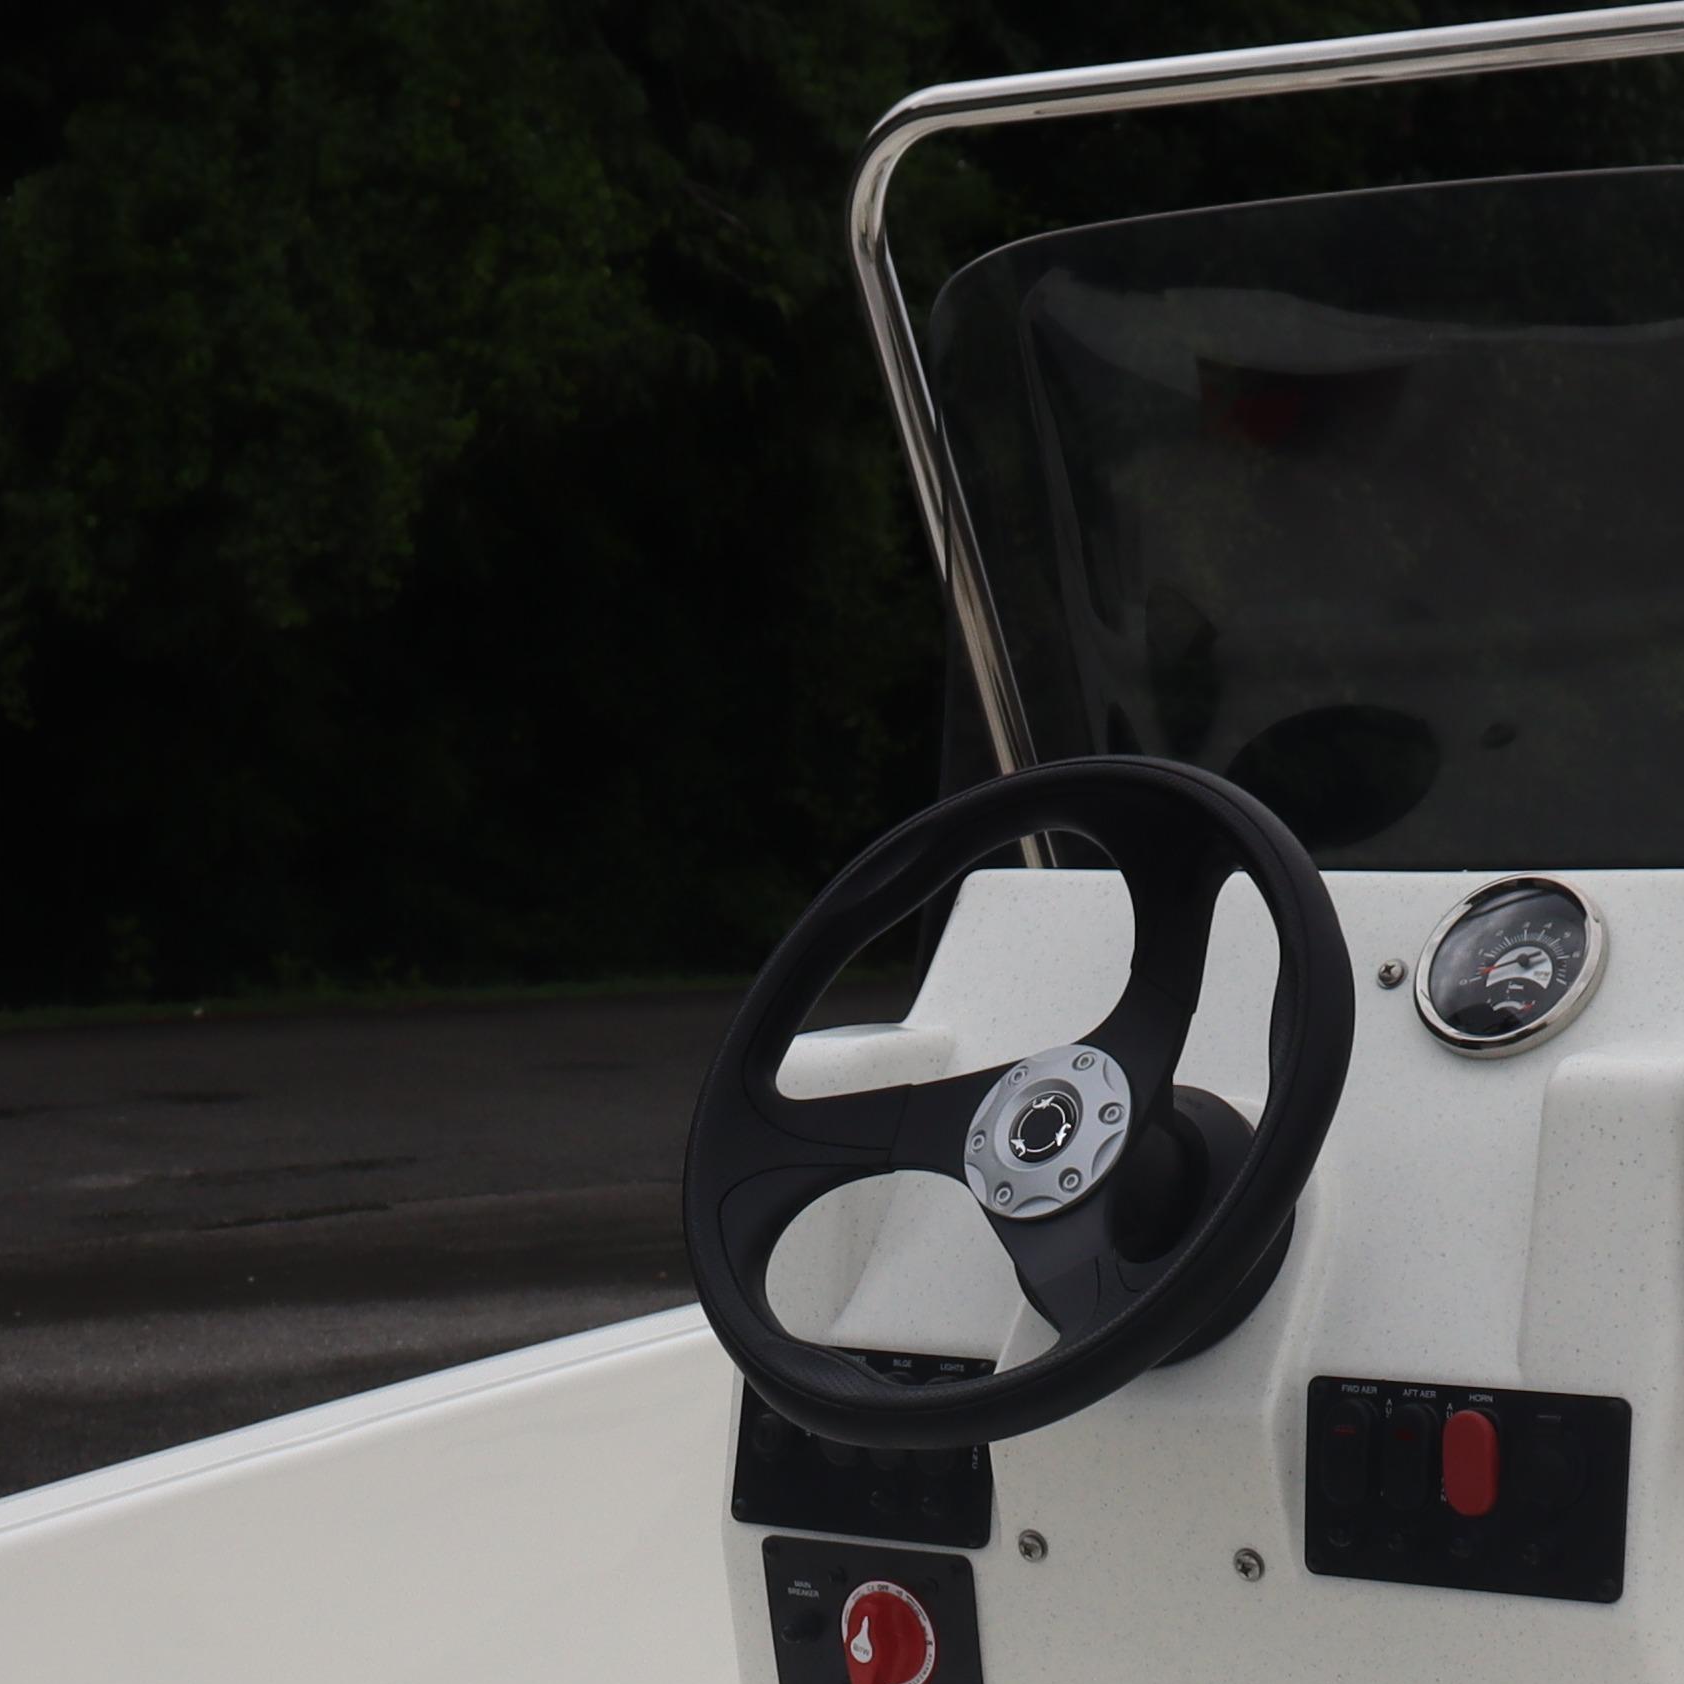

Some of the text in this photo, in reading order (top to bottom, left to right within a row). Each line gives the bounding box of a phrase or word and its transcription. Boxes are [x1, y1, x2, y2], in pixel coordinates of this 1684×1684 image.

[939, 1362, 964, 1373] LIGHTS
[1341, 1384, 1378, 1396] FWD AER
[1403, 1389, 1437, 1399] AFT AER
[1469, 1393, 1494, 1404] HORN
